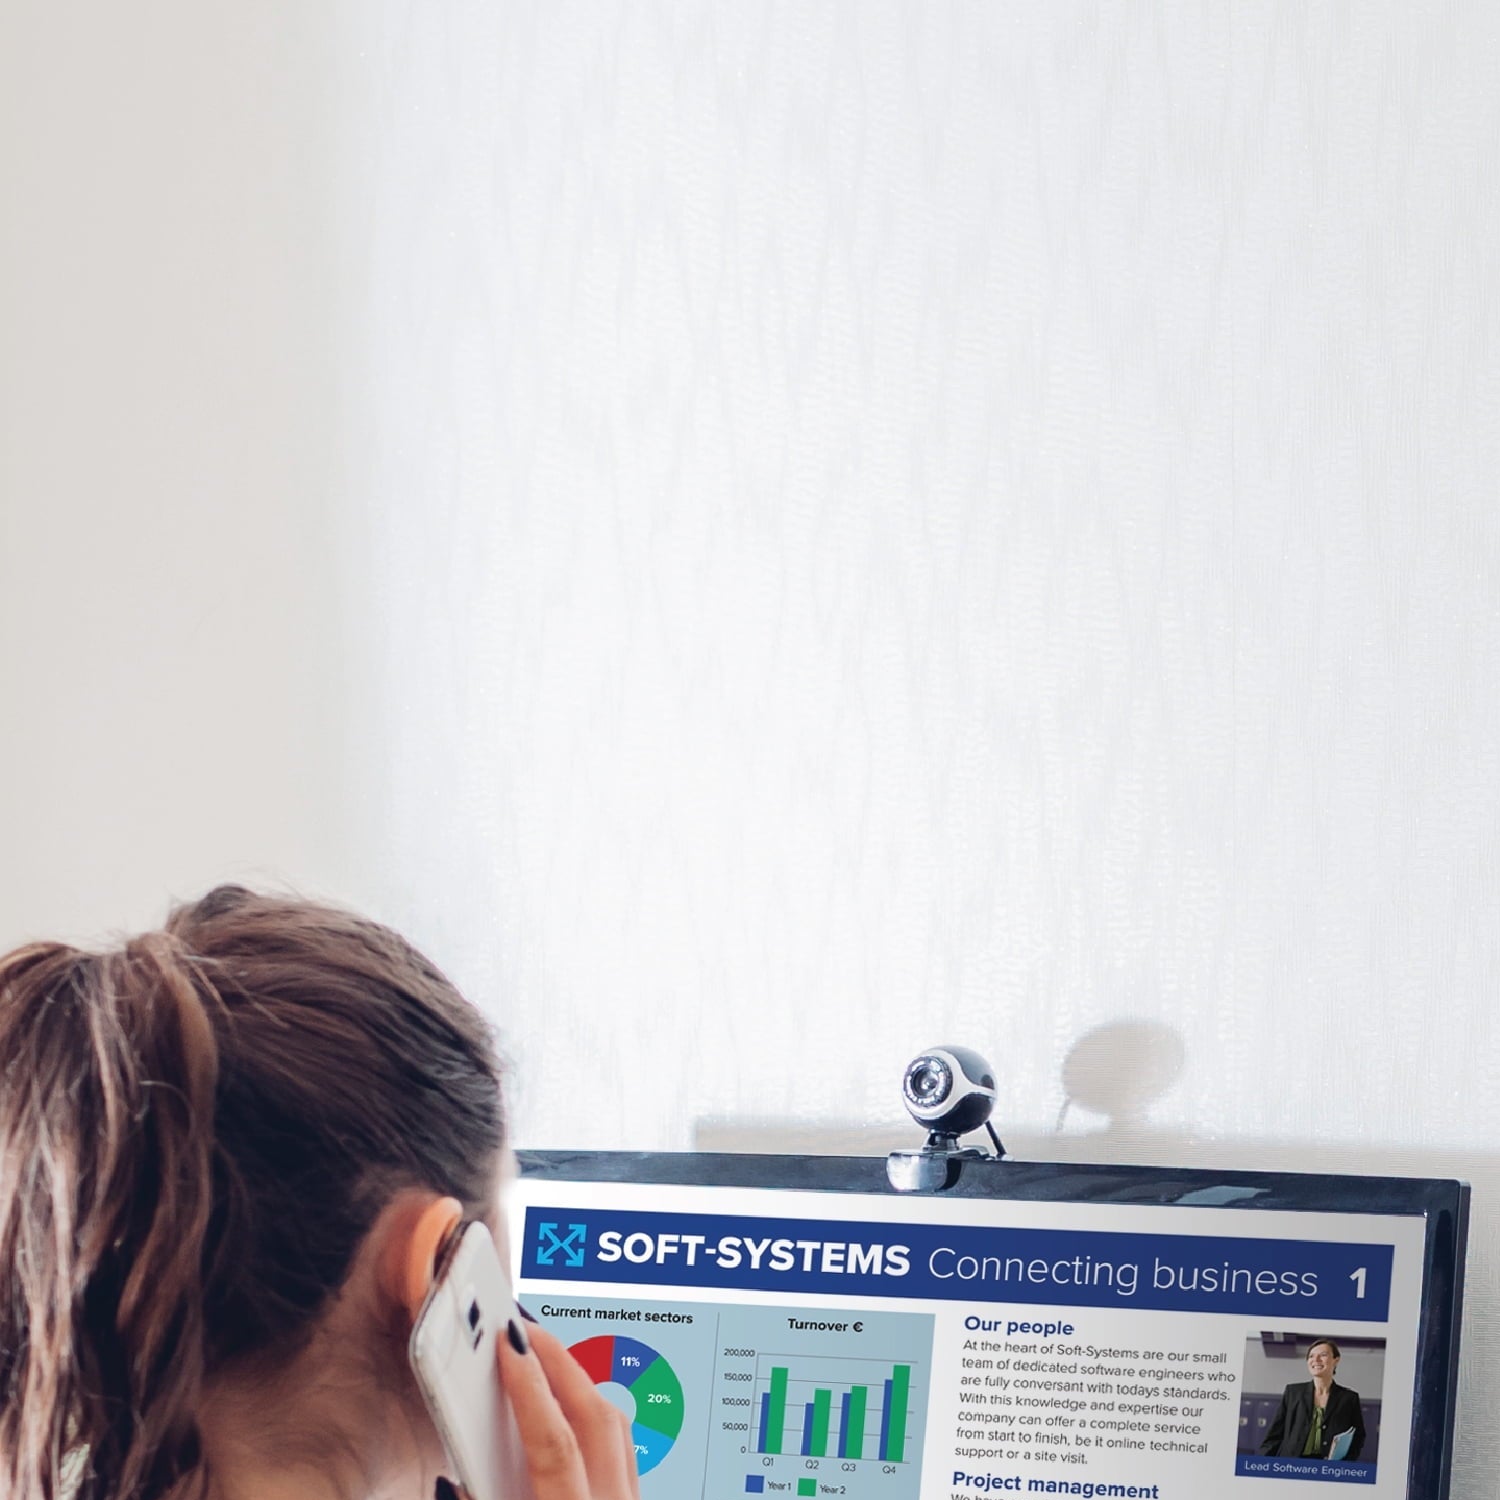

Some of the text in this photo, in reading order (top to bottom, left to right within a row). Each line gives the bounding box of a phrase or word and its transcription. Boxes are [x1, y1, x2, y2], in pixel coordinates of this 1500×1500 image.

[596, 1231, 1366, 1298] SOFT-SYSTEMS Connecting business 1
[540, 1304, 693, 1324] Current market sectors
[787, 1317, 863, 1333] Turnover €
[964, 1315, 1075, 1338] Our people
[620, 1356, 640, 1367] 11%
[962, 1339, 1227, 1363] At the heart of Soft-Systems are our small
[961, 1357, 1236, 1382] team of dedicated software engineers who
[960, 1375, 1230, 1400] are fully conversant with todays standards.
[647, 1393, 671, 1404] 20%
[959, 1392, 1204, 1417] With this knowledge and expertise our
[957, 1410, 1201, 1435] company can offer a complete service
[956, 1426, 1208, 1453] from start to finish, be it online technical
[761, 1456, 896, 1474] Q1 Q2 Q3 Q4
[954, 1447, 1088, 1464] support or a site visit.
[1244, 1460, 1367, 1478] Lead Software Engineer
[767, 1481, 791, 1491] Year 1
[819, 1484, 846, 1495] Year 2
[952, 1471, 1159, 1499] Project management
